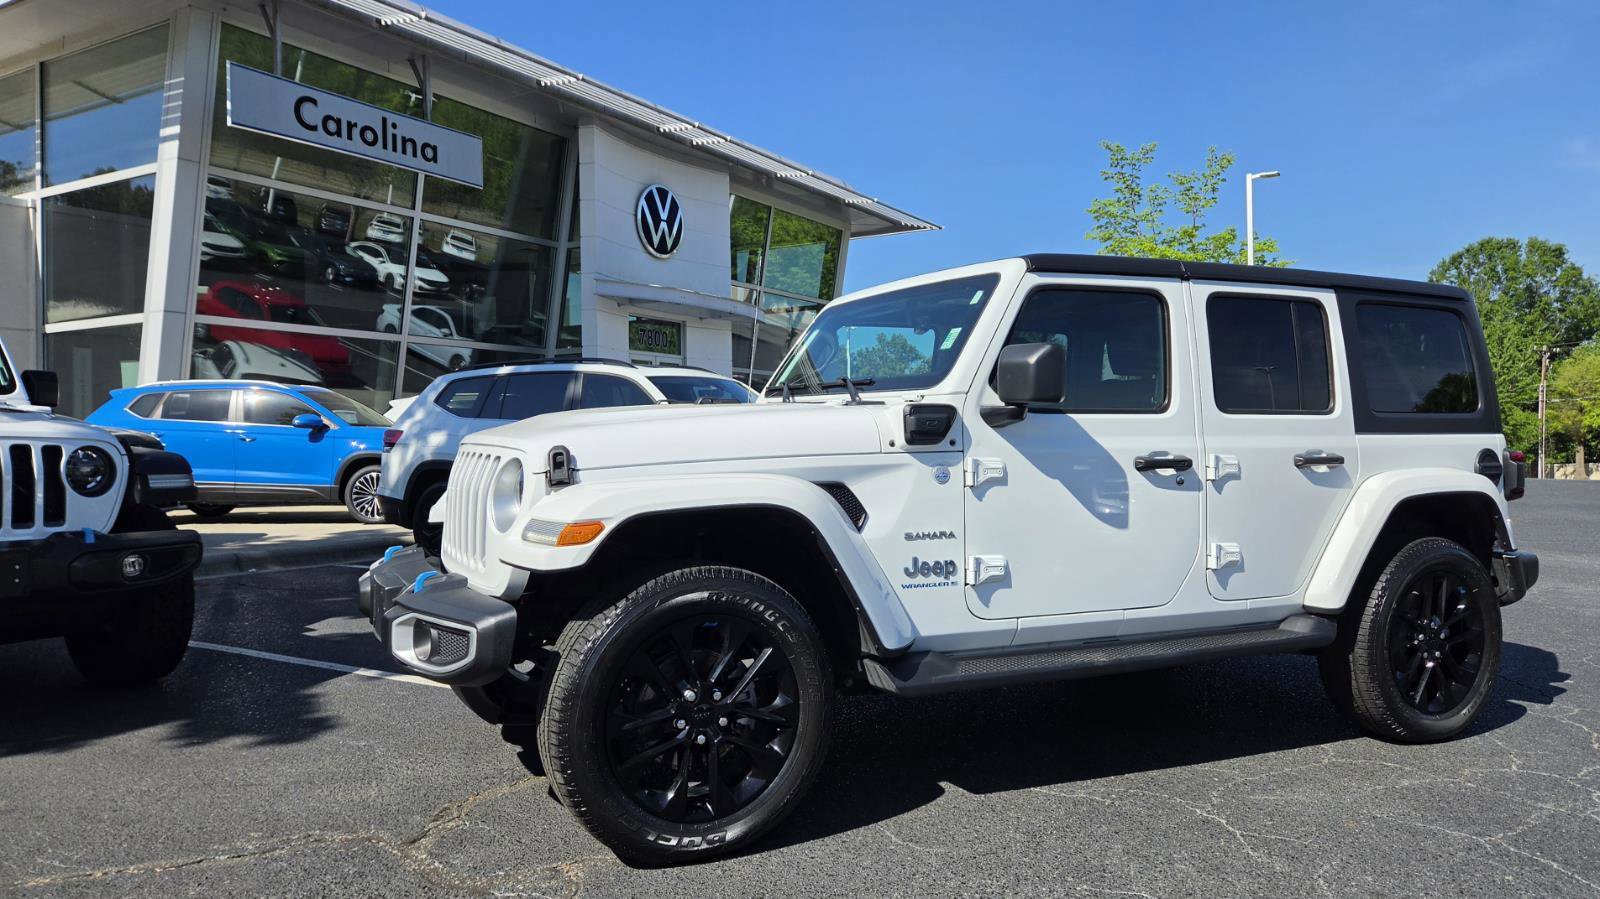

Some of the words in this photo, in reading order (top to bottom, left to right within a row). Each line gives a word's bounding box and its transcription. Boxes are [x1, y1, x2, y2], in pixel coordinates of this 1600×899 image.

[293, 95, 438, 164] Carolina
[640, 186, 682, 252] VW
[638, 328, 668, 348] 7800
[904, 531, 957, 541] SAHARA
[905, 556, 958, 580] Jeep
[902, 581, 949, 590] WRANGLER
